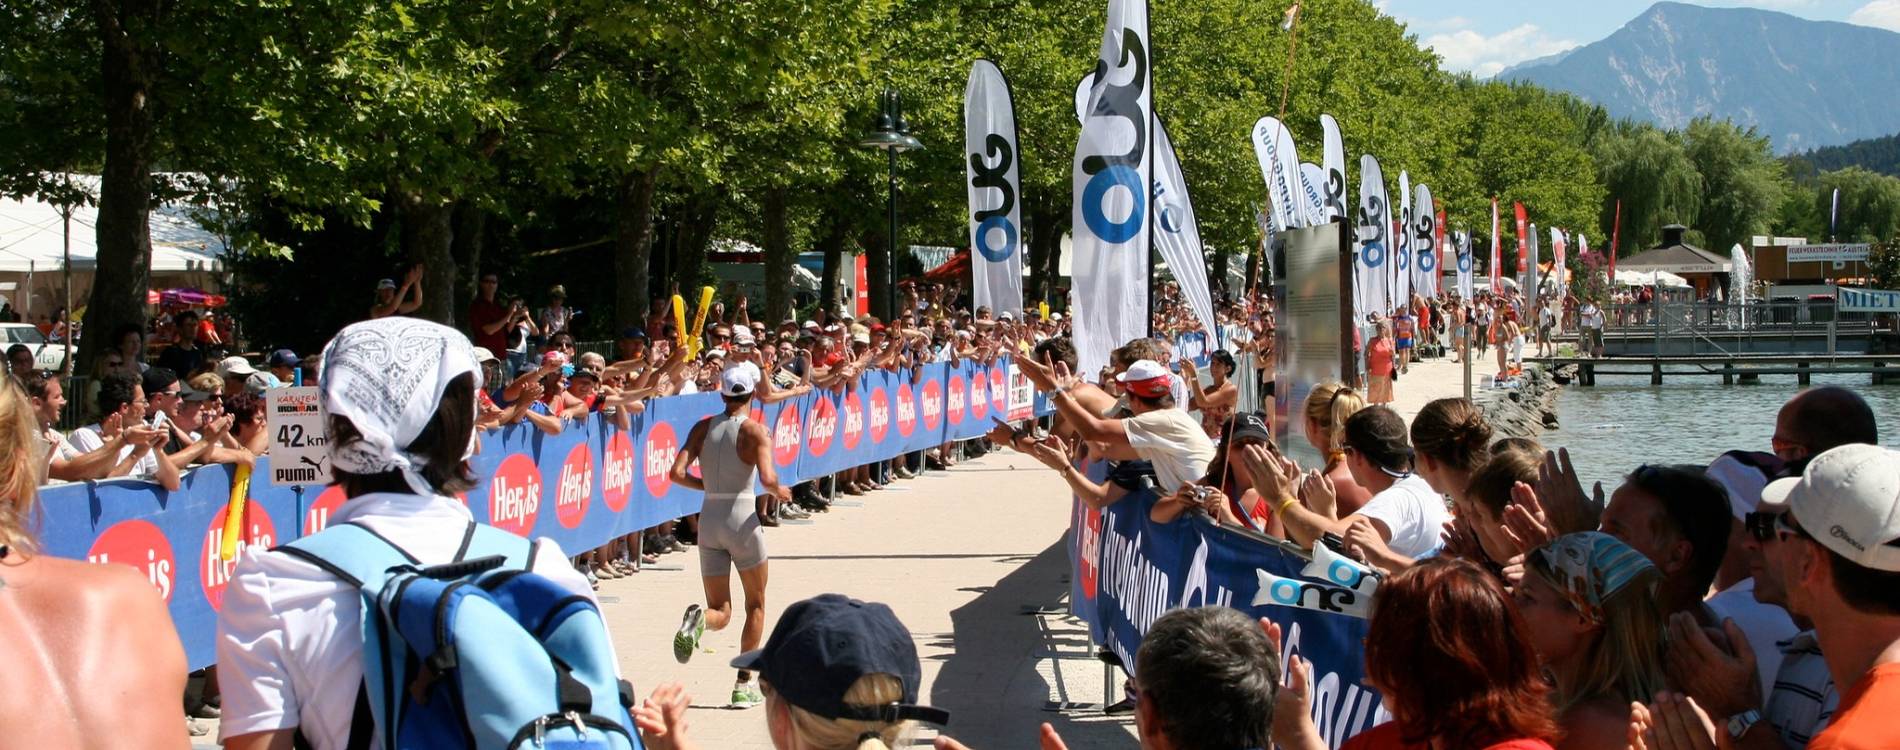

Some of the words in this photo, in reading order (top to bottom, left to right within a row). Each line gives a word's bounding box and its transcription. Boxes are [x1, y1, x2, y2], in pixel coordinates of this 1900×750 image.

[971, 133, 1018, 263] one
[1360, 195, 1385, 268] one
[1416, 215, 1436, 273] one
[277, 424, 305, 448] 42
[276, 468, 316, 481] PUMA
[605, 449, 633, 494] Hervis
[494, 475, 539, 526] Hervis
[1270, 580, 1356, 613] one
